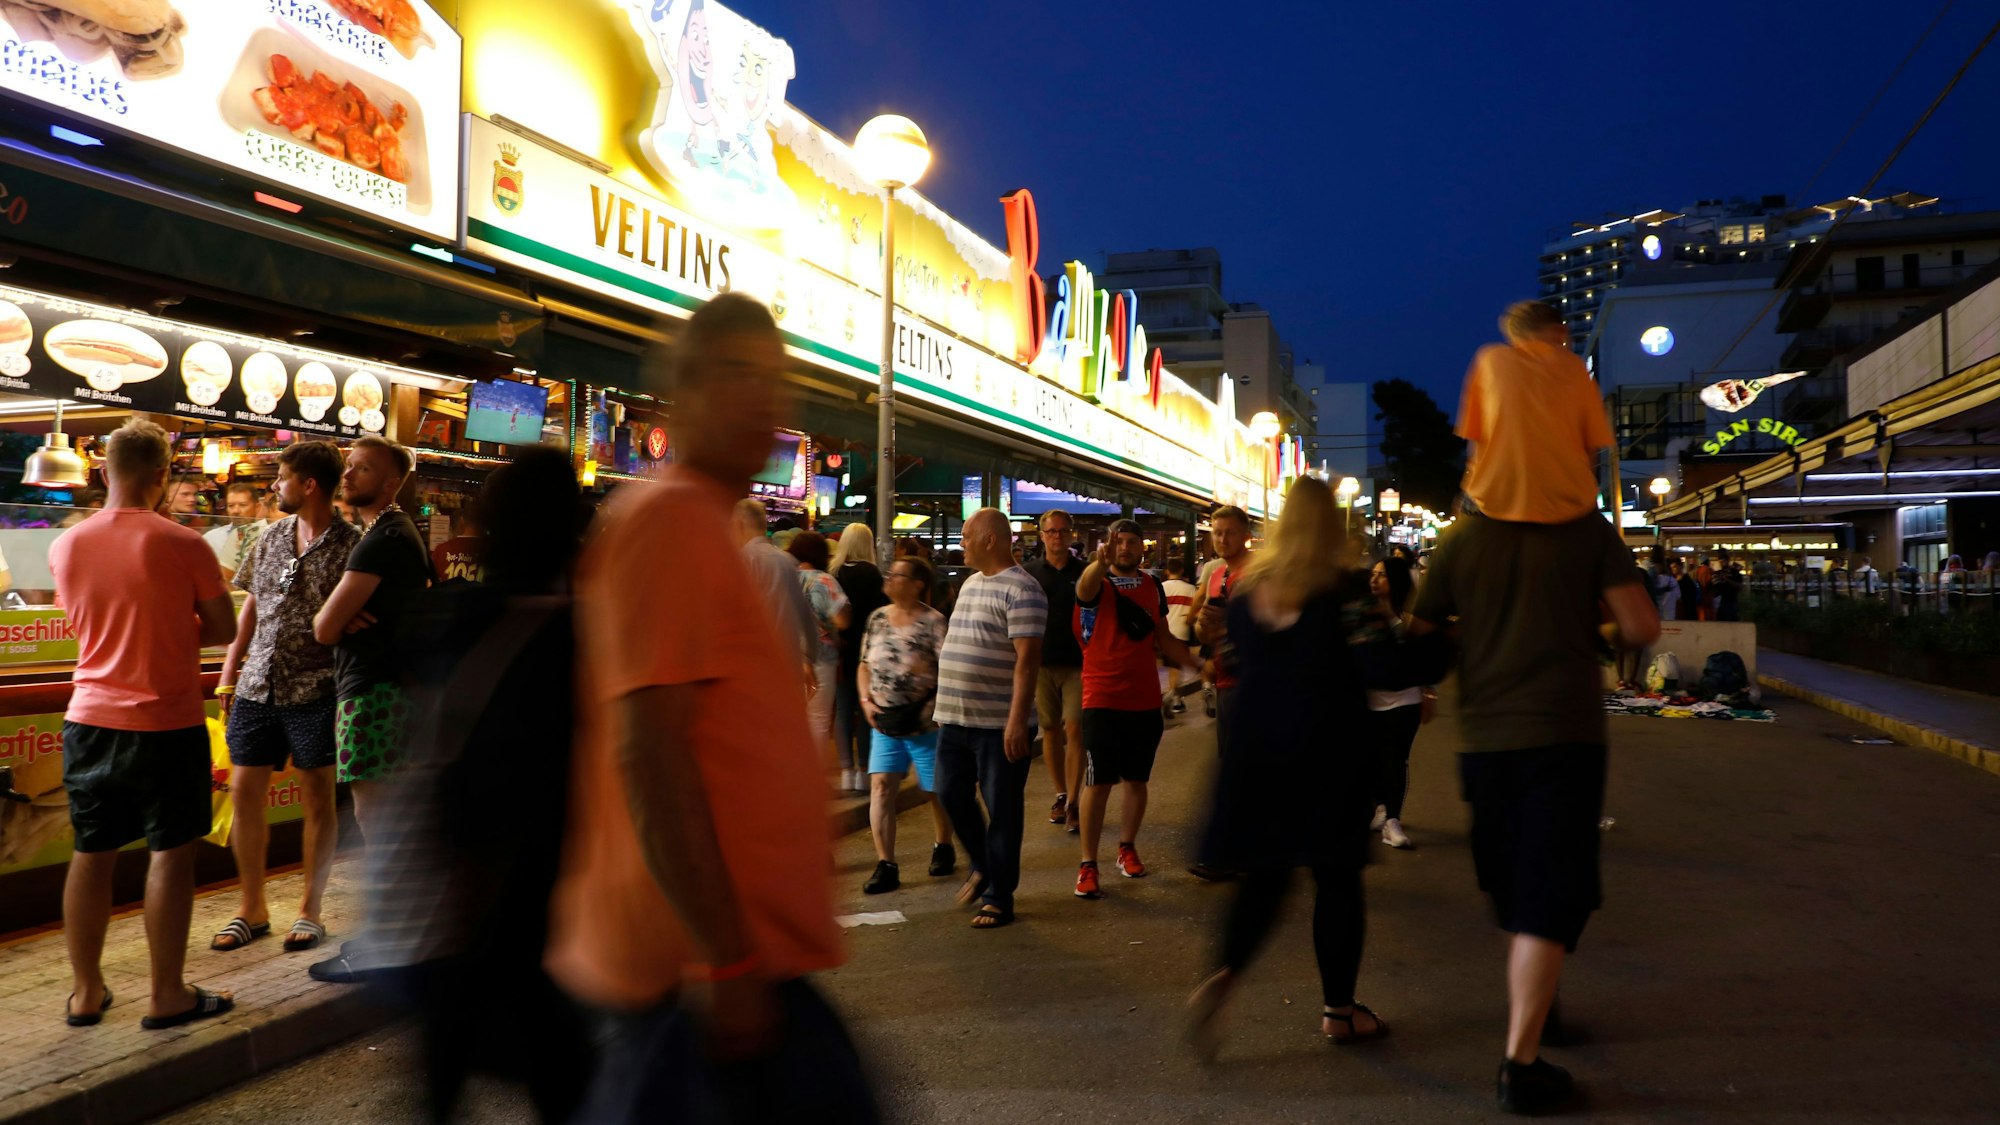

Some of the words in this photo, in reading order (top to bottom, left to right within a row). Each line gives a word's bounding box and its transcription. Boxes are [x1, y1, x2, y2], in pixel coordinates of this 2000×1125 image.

[590, 184, 733, 294] VELTINS
[75, 387, 91, 399] Mit
[93, 390, 132, 404] Brötchen
[176, 402, 190, 412] Mit
[191, 404, 227, 418] Brötchen
[236, 411, 249, 421] Mit
[250, 412, 283, 425] Brötchen
[1702, 419, 1750, 456] SAN
[9, 644, 38, 655] SOSSE
